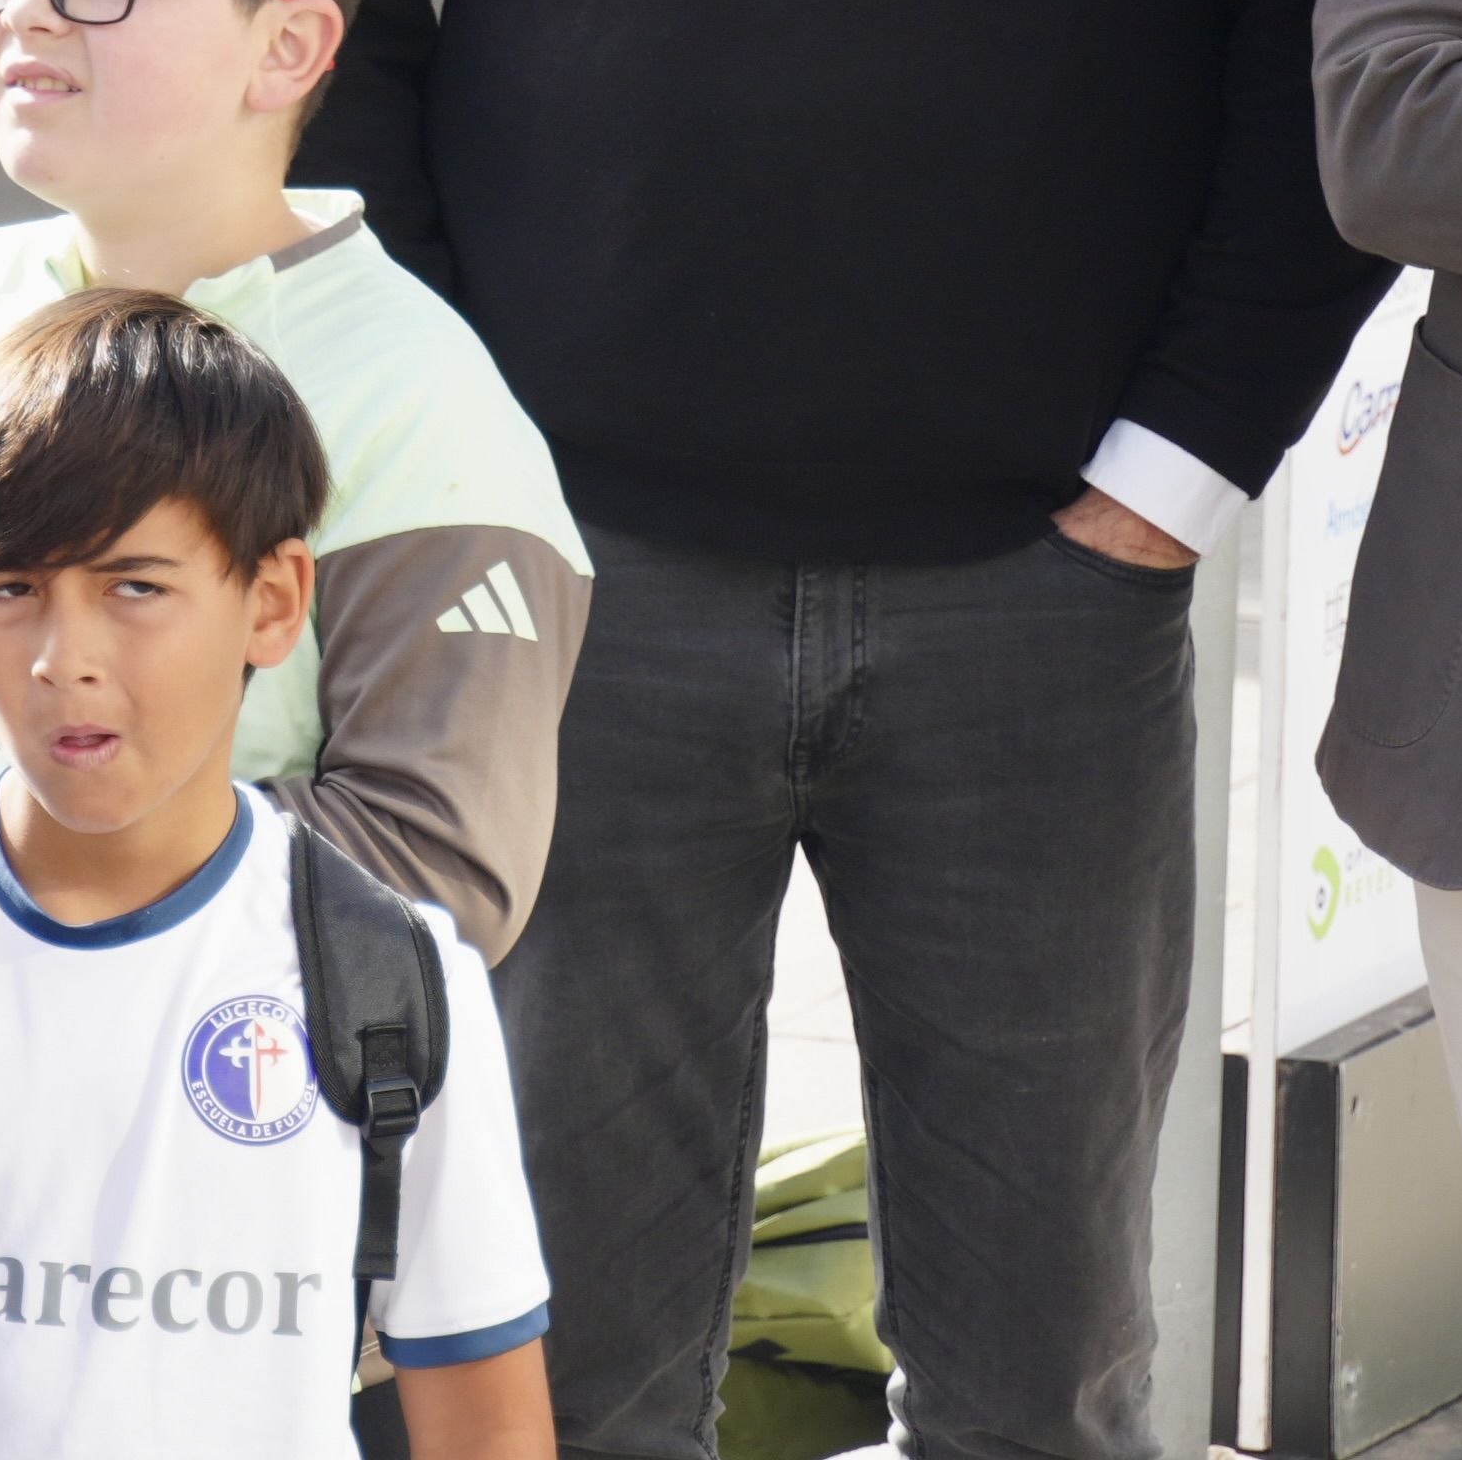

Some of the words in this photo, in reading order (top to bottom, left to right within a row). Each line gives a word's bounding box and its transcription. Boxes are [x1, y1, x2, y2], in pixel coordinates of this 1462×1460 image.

[209, 1001, 297, 1030] LUCECOR
[191, 1080, 247, 1137] ESCUELA
[251, 1124, 272, 1138] DE
